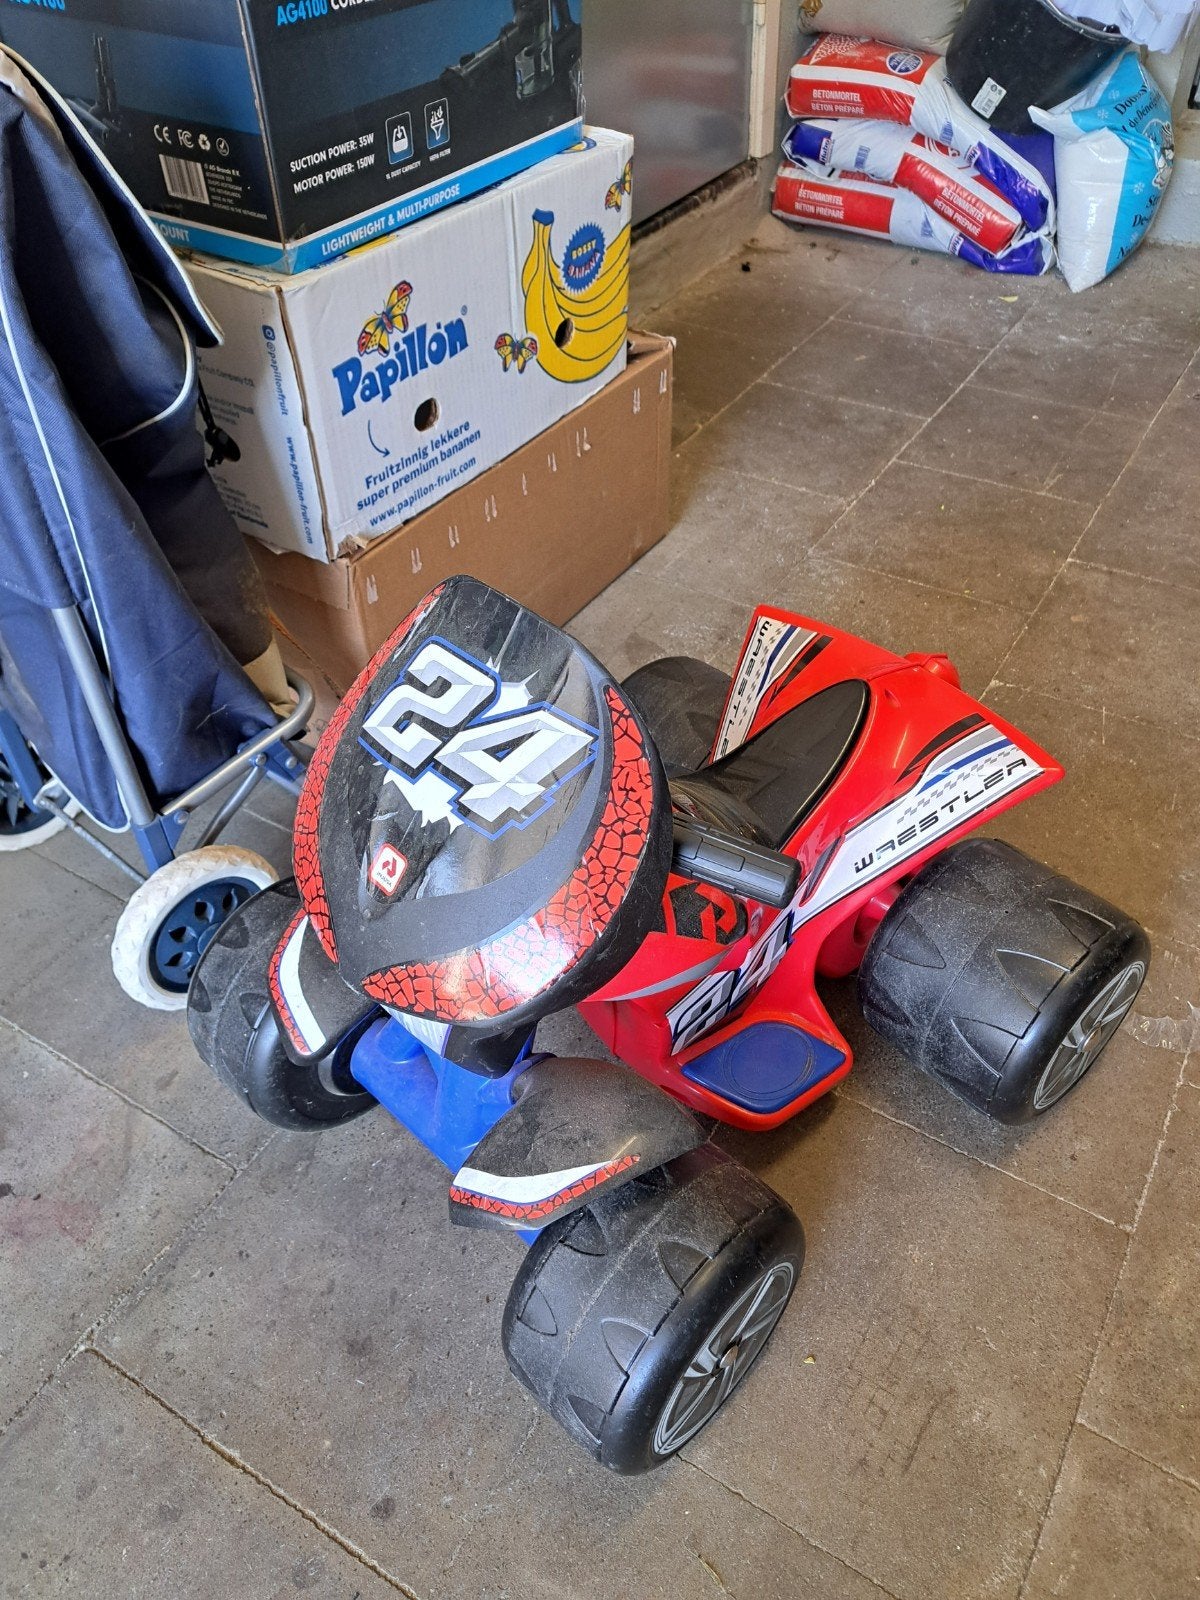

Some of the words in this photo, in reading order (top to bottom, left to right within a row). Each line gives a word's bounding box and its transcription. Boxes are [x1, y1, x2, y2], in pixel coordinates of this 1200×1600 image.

[276, 0, 328, 26] AG4100
[812, 89, 861, 102] BETONMORTEL
[290, 151, 326, 173] SUCTION
[328, 140, 357, 160] POWER:
[358, 132, 374, 148] 35W
[293, 174, 324, 194] MOTOR
[325, 163, 354, 182] POWER:
[356, 154, 375, 170] 150W
[321, 217, 386, 256] LIGHTWEIGHT
[388, 213, 395, 226] &
[397, 183, 460, 222] MULTI-PURPOSE
[798, 187, 844, 206] BETONMORTEL
[941, 187, 985, 224] BETONMORTEL
[571, 239, 597, 260] BOSSY
[356, 484, 390, 511] super
[391, 456, 439, 494] premium
[440, 429, 481, 462] bananen
[365, 446, 429, 490] Fruitzinnig
[430, 420, 471, 452] lekkere
[369, 456, 477, 527] www.papillon-fruit.com
[720, 620, 772, 758] WRESTLE
[358, 640, 597, 832] 24
[854, 757, 1028, 874] WRESTLER
